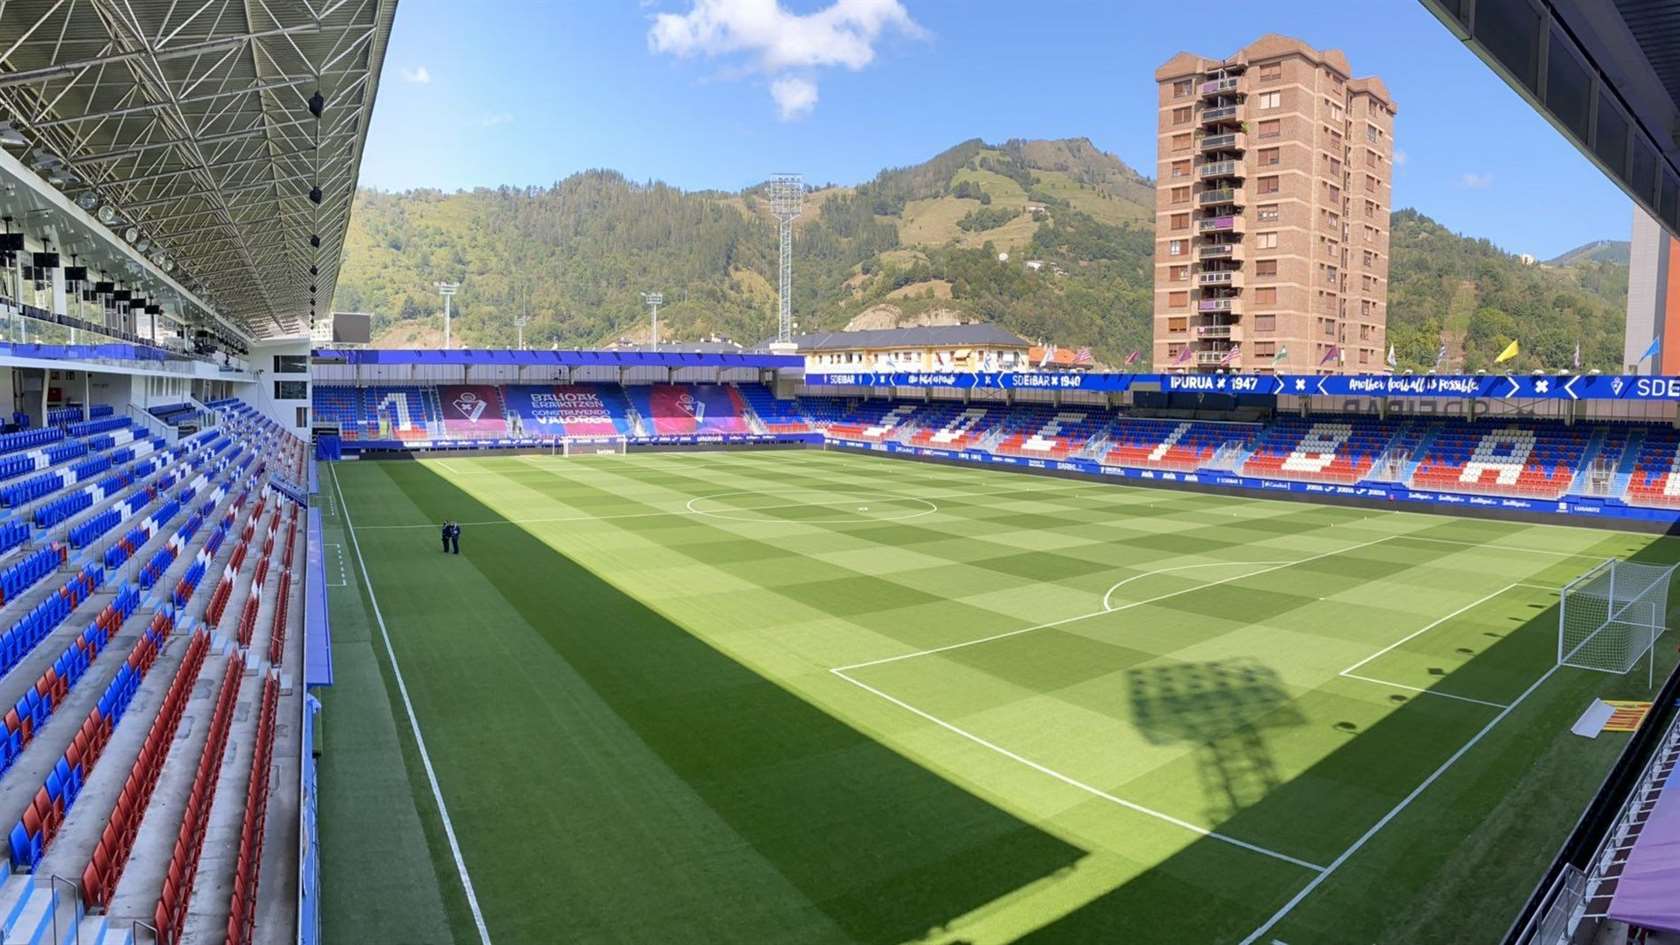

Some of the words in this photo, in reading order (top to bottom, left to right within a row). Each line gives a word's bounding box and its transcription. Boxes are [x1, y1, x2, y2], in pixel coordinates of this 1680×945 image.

[1060, 375, 1081, 387] 1940
[1170, 376, 1213, 389] IPURUA
[1231, 377, 1258, 391] 1947
